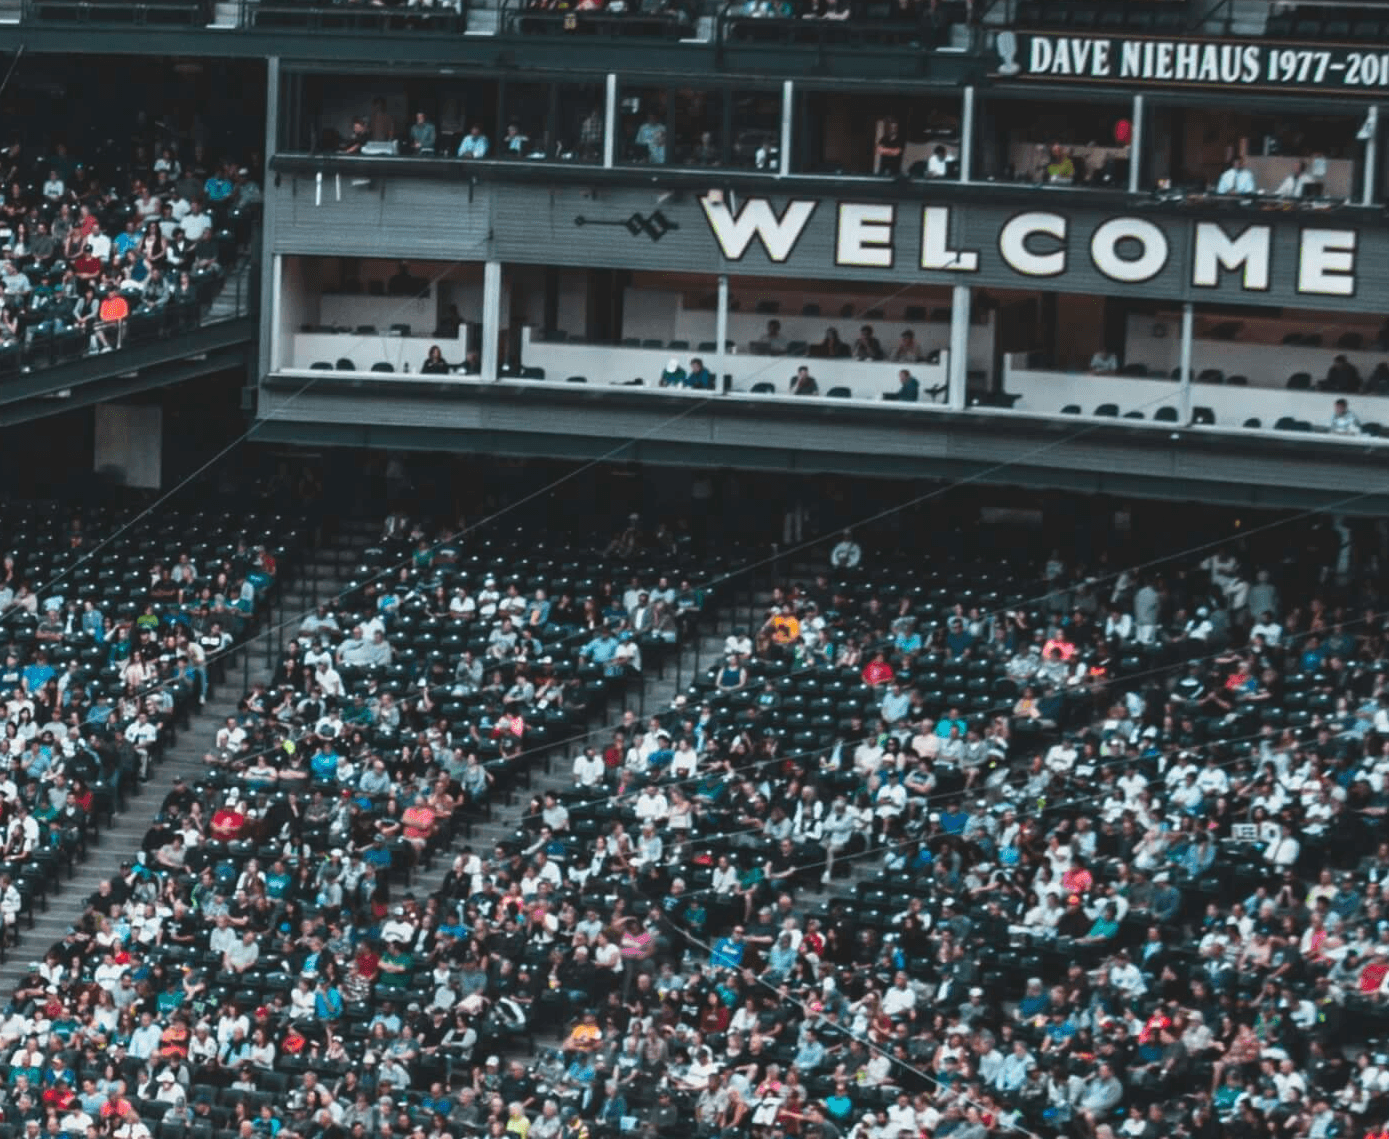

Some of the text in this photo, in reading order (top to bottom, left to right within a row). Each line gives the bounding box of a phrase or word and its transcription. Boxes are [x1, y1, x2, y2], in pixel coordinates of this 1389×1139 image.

[1030, 37, 1110, 75] DAVE
[1121, 41, 1260, 83] NIEHAUS
[699, 197, 1357, 296] WELCOME
